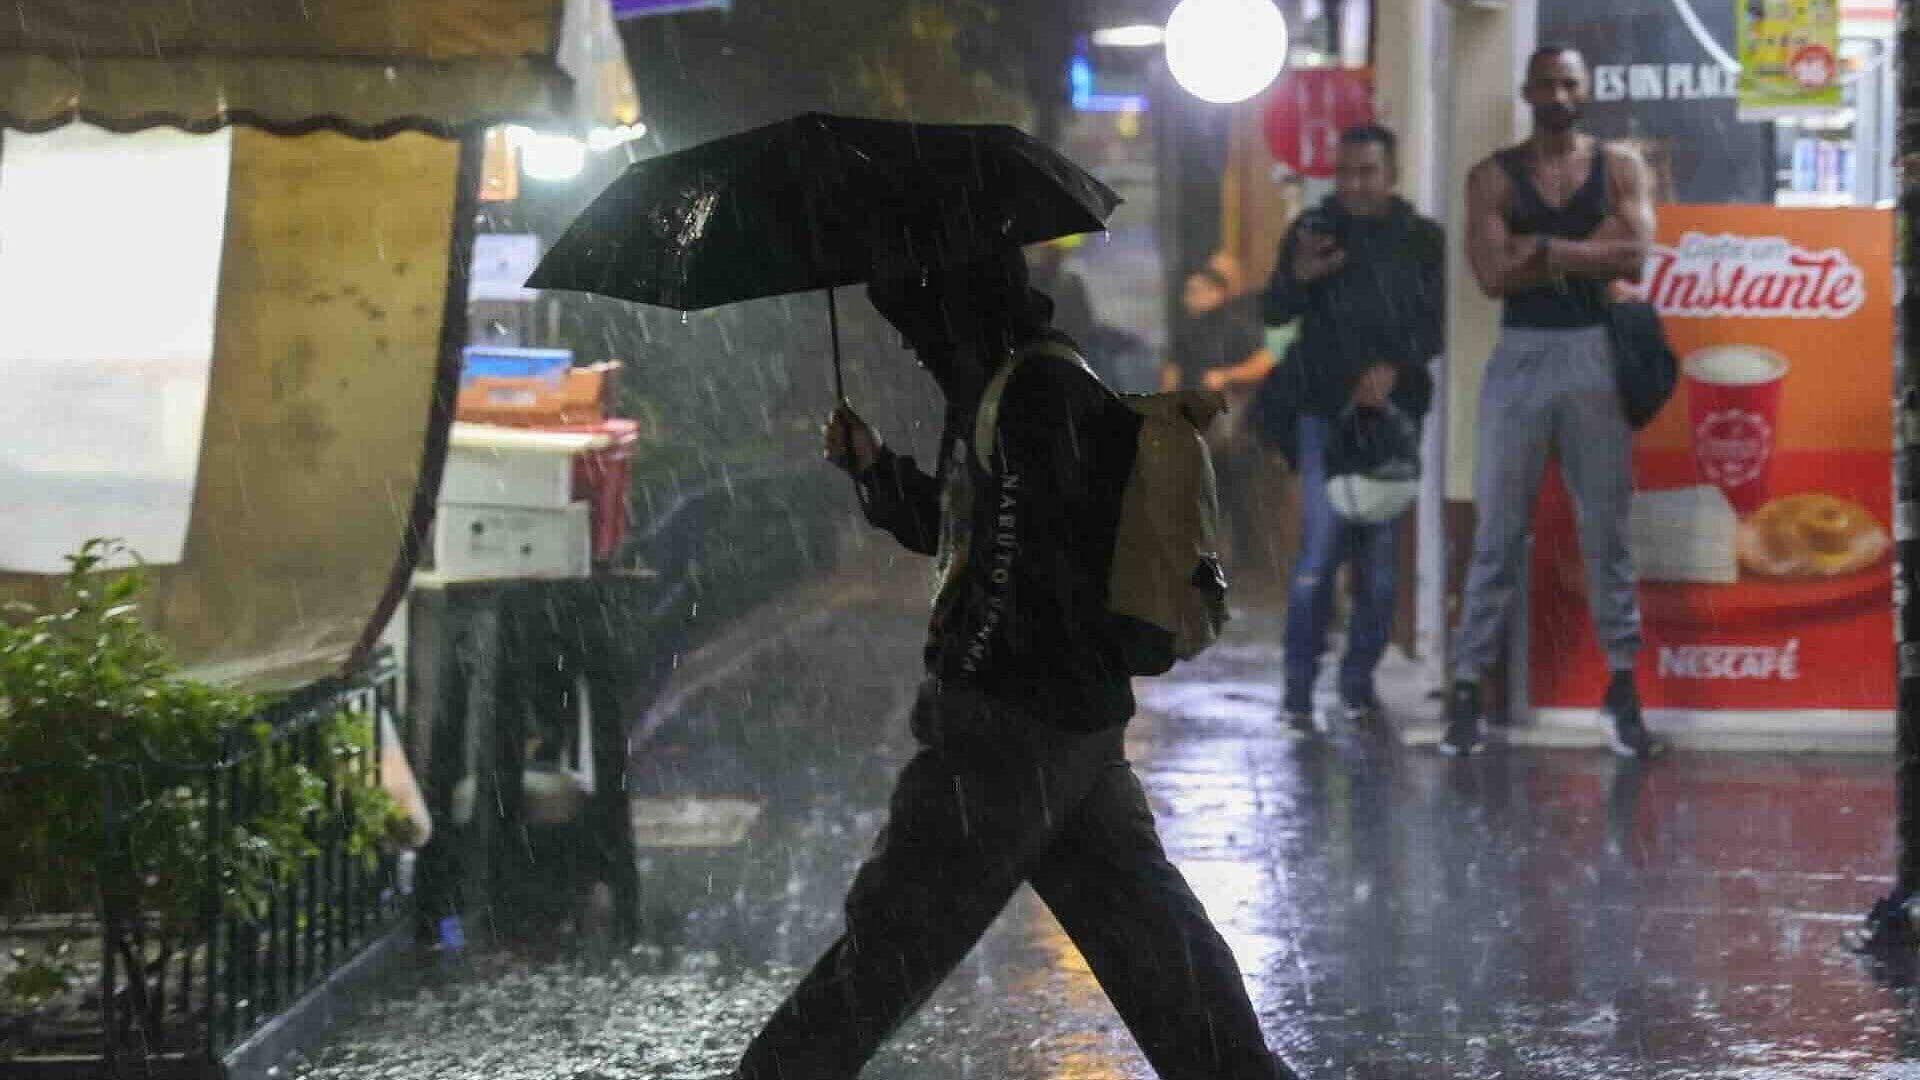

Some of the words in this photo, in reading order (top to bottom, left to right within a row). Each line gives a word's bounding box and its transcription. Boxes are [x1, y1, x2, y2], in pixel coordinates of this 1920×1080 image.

[1594, 64, 1625, 102] ES
[1644, 250, 1858, 313] Instante
[991, 472, 1022, 584] NARUTO
[1657, 638, 1800, 680] NESCAFÉ
